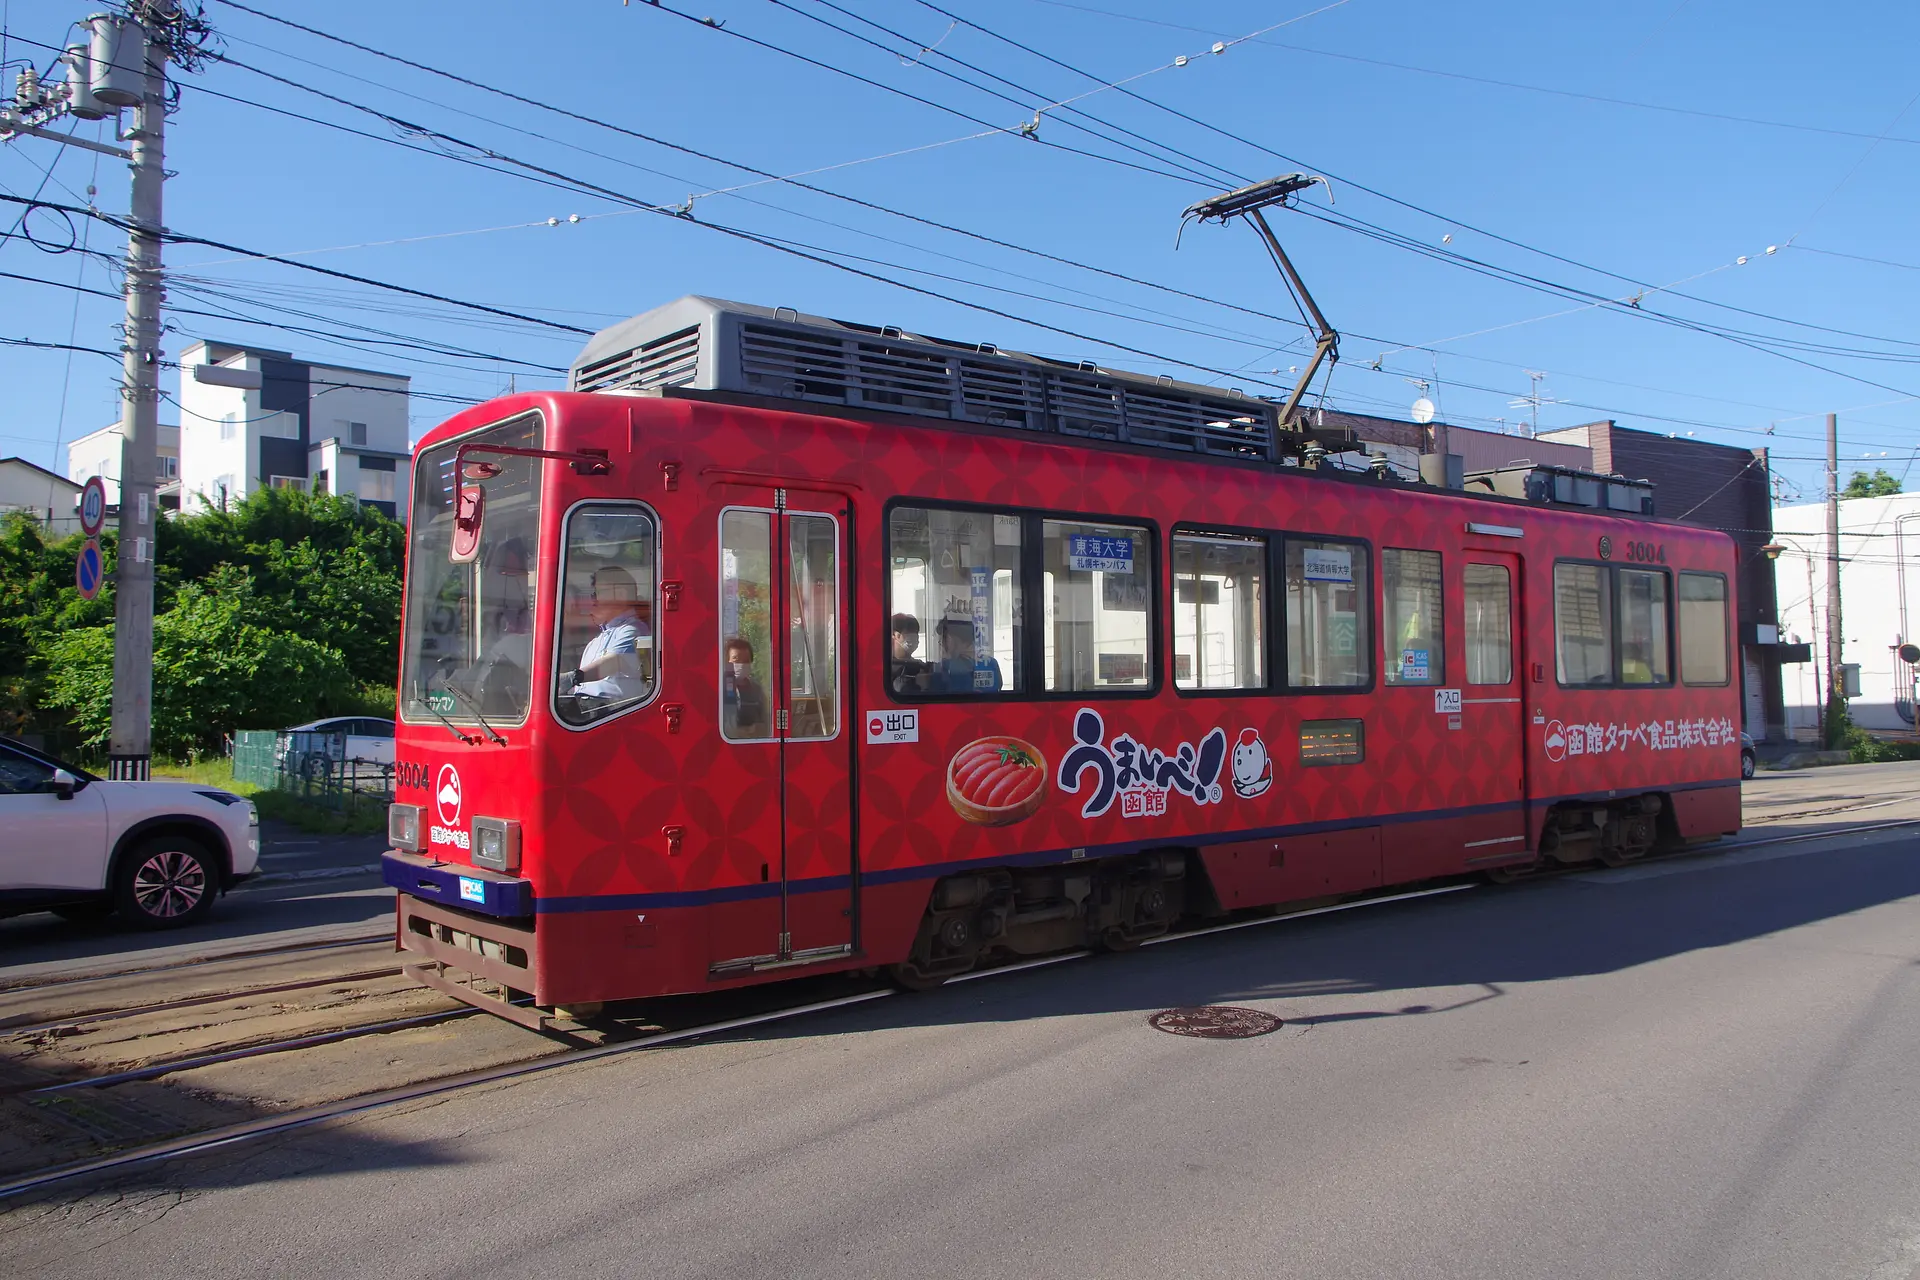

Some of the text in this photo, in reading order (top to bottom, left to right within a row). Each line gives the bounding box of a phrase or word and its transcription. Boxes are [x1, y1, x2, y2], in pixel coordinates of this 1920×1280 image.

[84, 493, 100, 518] 40
[1074, 537, 1128, 558] 東海大学
[1627, 541, 1666, 564] 3004
[1077, 558, 1127, 570] 札幌キャンパス
[1306, 562, 1350, 576] 北海道情報大学
[429, 696, 455, 711] ワンマン
[1444, 691, 1460, 704] 入口
[886, 713, 915, 731] 出口
[893, 733, 907, 741] EXIT
[1566, 716, 1736, 756] 函館タナベ食品株式会社
[397, 760, 430, 791] 3004
[1124, 788, 1165, 814] 函館
